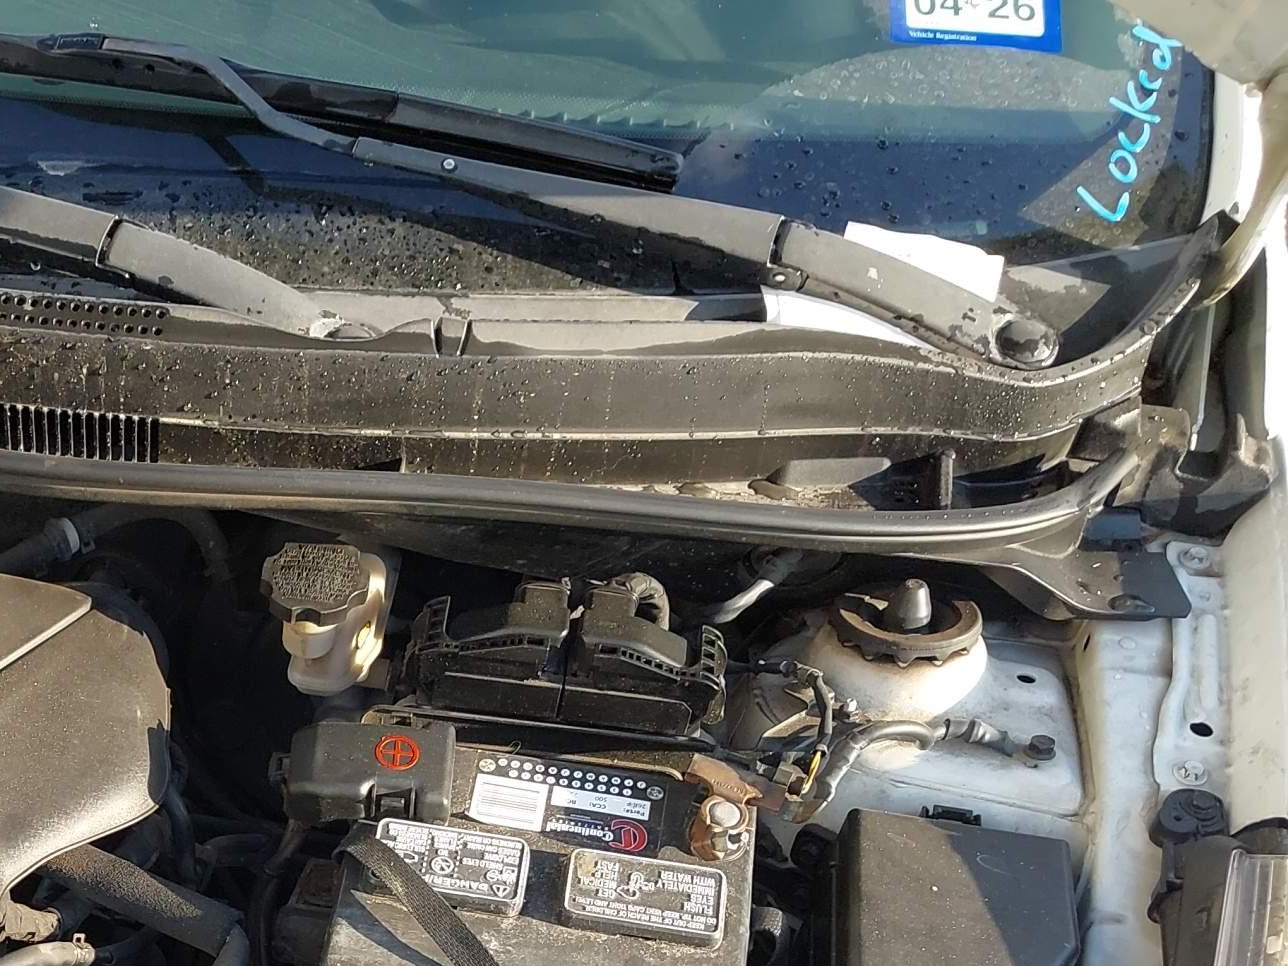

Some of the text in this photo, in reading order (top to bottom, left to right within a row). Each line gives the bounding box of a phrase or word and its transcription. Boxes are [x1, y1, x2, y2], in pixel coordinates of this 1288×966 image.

[988, 0, 1035, 21] 26
[909, 30, 977, 41] Vehicle Registration
[546, 822, 614, 842] Continental
[596, 860, 620, 872] FAST
[594, 870, 618, 881] HELP
[660, 870, 715, 889] WITH WATER
[578, 876, 618, 890] MEDICAL
[657, 878, 715, 897] IMMEDIATELY
[597, 889, 616, 900] GET
[690, 893, 714, 906] EYES
[683, 901, 713, 916] FLUSH
[627, 911, 650, 922] REACH
[686, 921, 705, 931] KEEP
